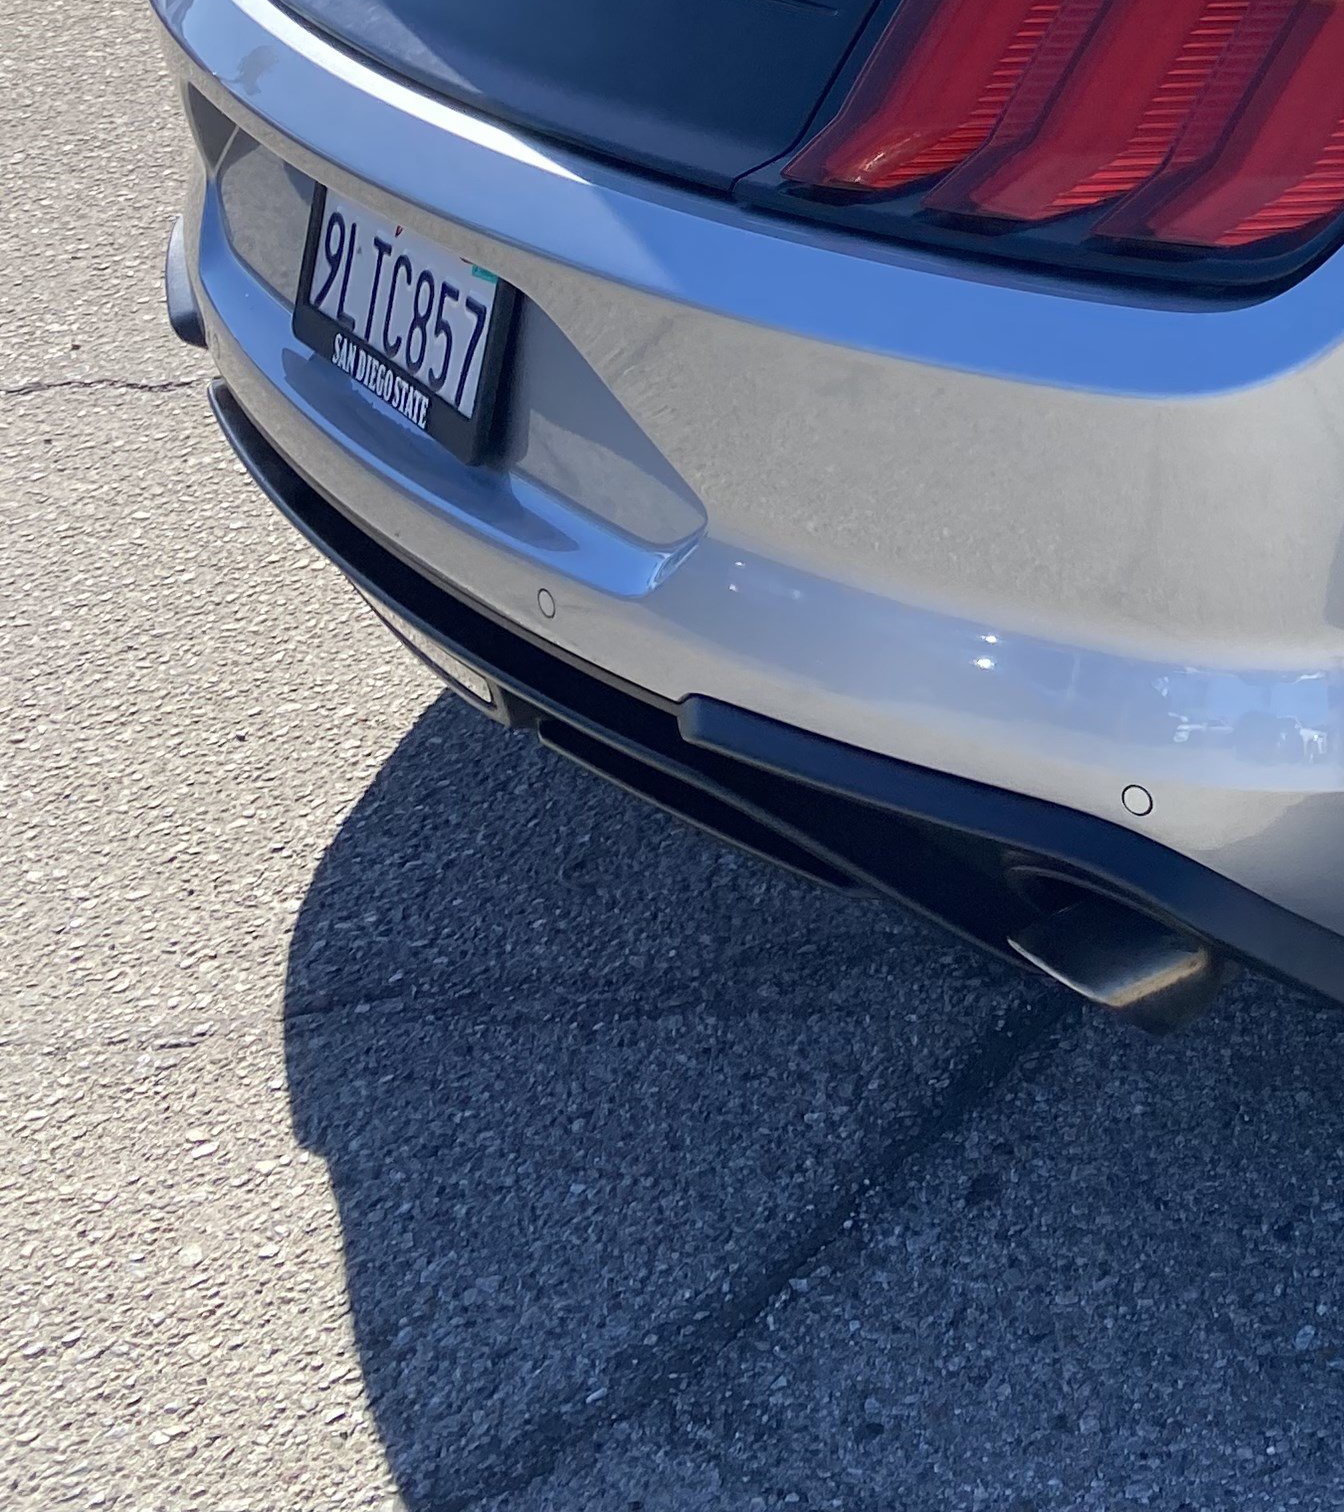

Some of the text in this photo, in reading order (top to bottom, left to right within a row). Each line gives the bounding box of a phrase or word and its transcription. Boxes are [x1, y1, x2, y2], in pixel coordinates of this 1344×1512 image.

[314, 211, 488, 410] 9LTC857
[332, 333, 429, 429] SAN DIEGO STATE
